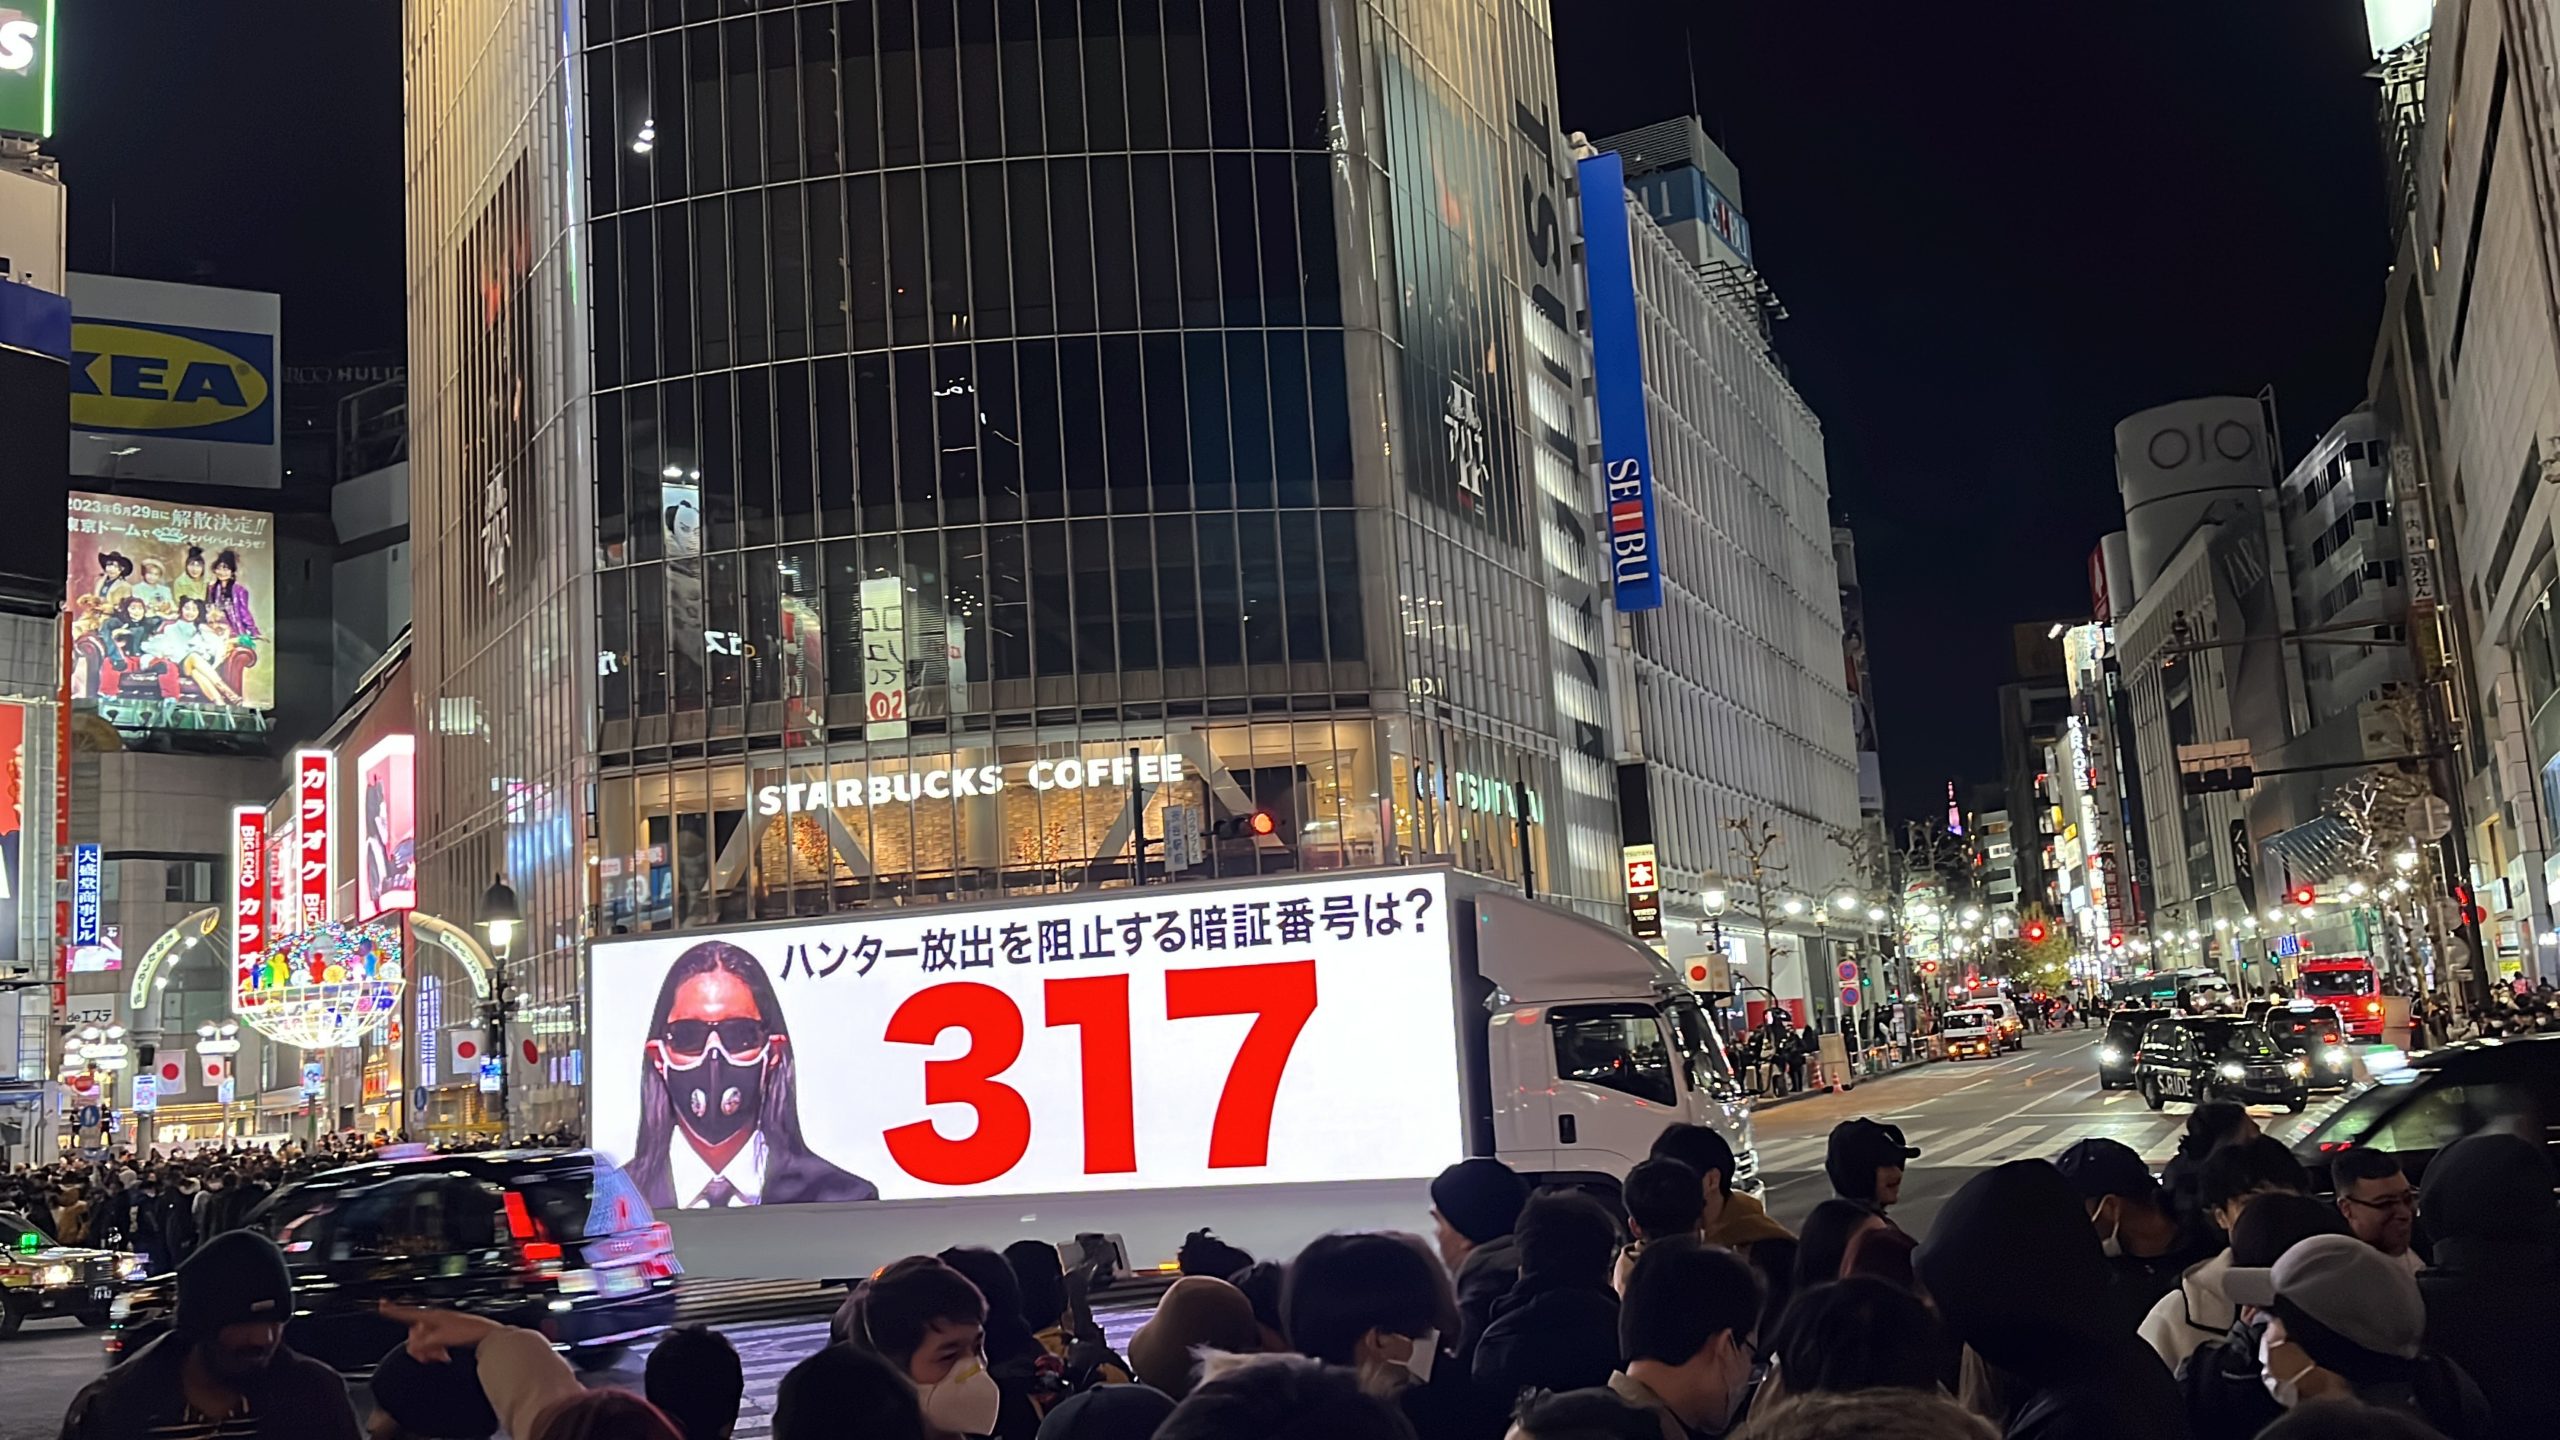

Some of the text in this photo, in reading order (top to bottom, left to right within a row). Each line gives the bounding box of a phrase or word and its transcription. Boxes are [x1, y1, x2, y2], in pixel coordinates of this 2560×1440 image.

[1607, 458, 1650, 584] SEIBU
[758, 753, 1184, 816] STARBUCKS COFFEE
[2066, 715, 2090, 791] KARAOKE
[302, 768, 327, 882] カラオケ
[1455, 771, 1544, 825] TSUTAA
[241, 825, 257, 851] BIG
[241, 852, 257, 887] ECHO
[1630, 863, 1653, 886] 本
[79, 849, 98, 942] 大盛堂商事ビル
[779, 886, 1433, 981] ハンター放出を阻止する暗証番号は?
[883, 959, 1318, 1186] 317
